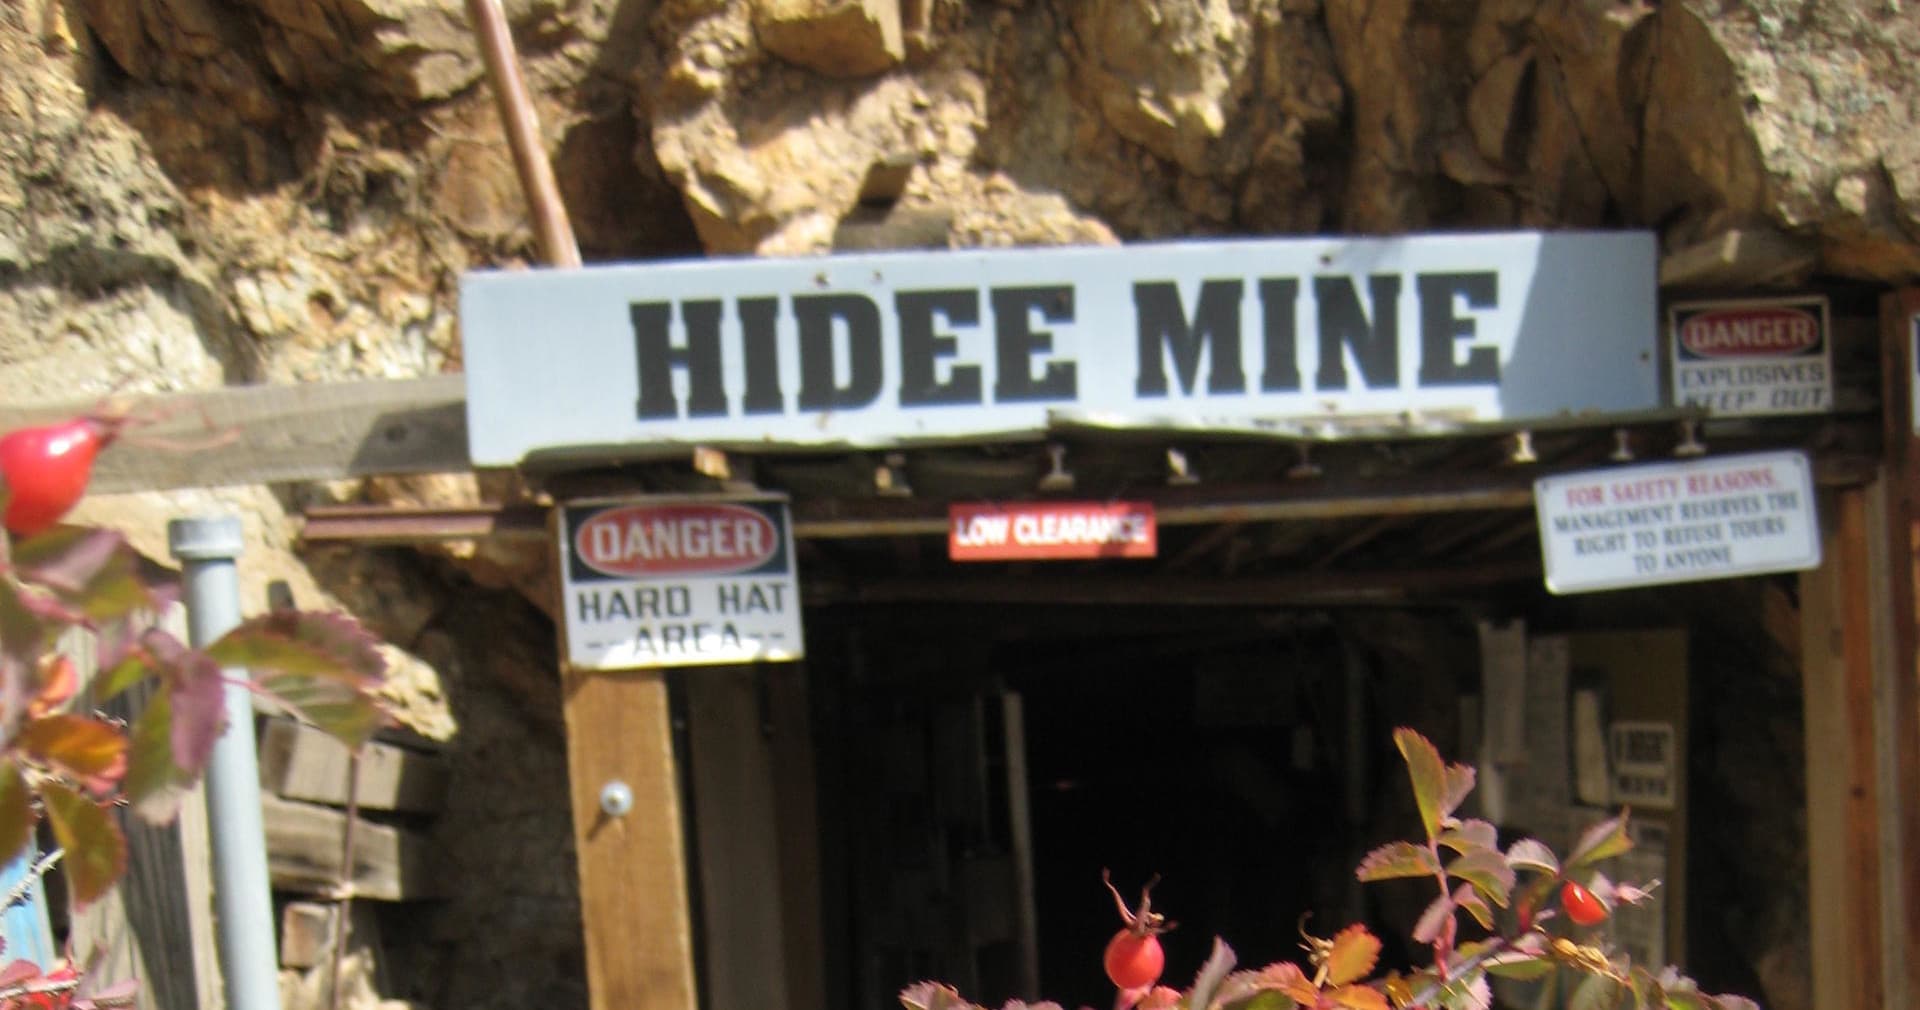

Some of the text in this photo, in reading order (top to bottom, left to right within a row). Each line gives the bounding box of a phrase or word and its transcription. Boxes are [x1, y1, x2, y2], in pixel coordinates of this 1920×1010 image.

[630, 270, 1500, 421] HIDEE MINE
[1689, 318, 1811, 347] DANGER
[1680, 364, 1826, 388] EXPLOSIVES
[1770, 388, 1826, 408] OUT
[1566, 486, 1604, 507] FOR
[1611, 478, 1680, 501] SAFETY
[1554, 491, 1799, 533] MANAGEMENT RESERVES THE
[591, 518, 762, 562] DANGER
[956, 513, 1148, 546] LOW CLEARANCE
[1574, 517, 1786, 556] RIGHT TO REFUSE TOURS
[1633, 547, 1733, 573] TO ANYONE
[577, 582, 788, 622] HARD HAT
